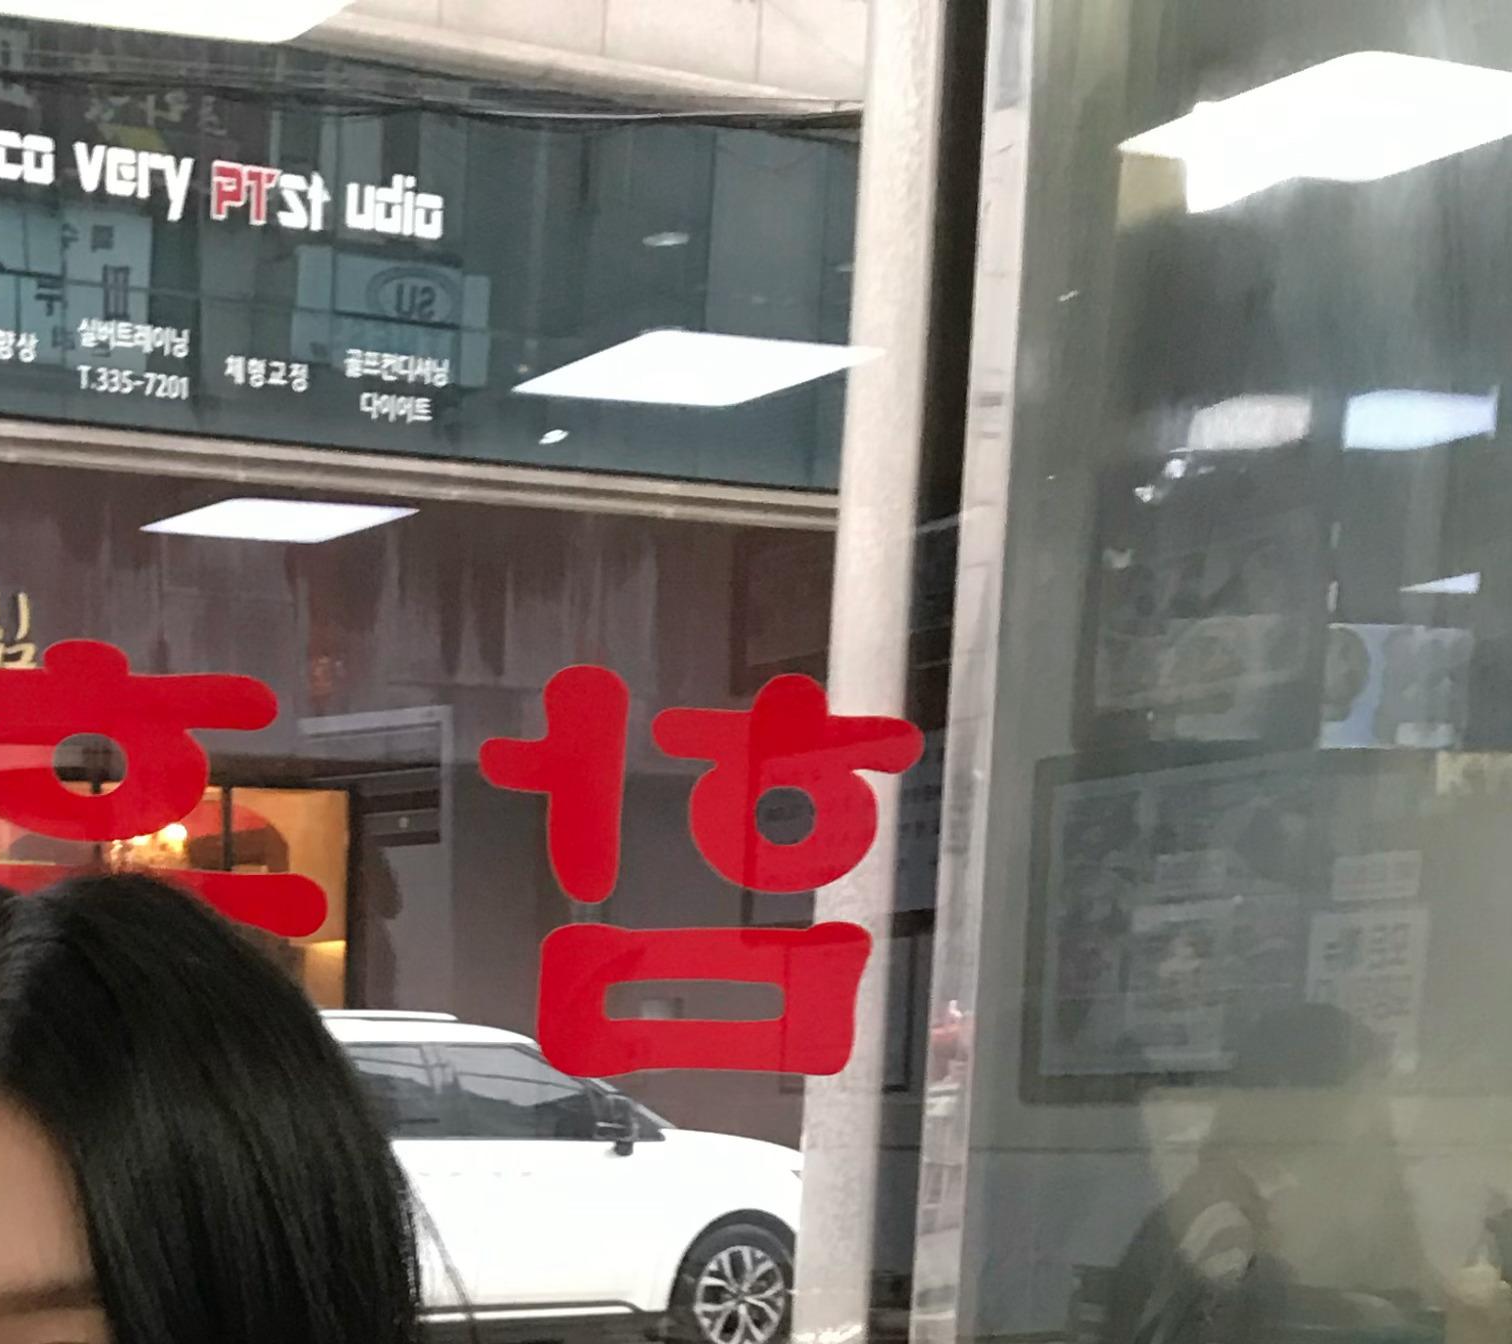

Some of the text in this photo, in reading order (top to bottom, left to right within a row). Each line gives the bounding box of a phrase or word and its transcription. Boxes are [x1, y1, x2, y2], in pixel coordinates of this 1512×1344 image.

[77, 365, 190, 400] T.335-7201
[224, 354, 310, 392] 체형교정
[359, 391, 433, 424] 다이어트
